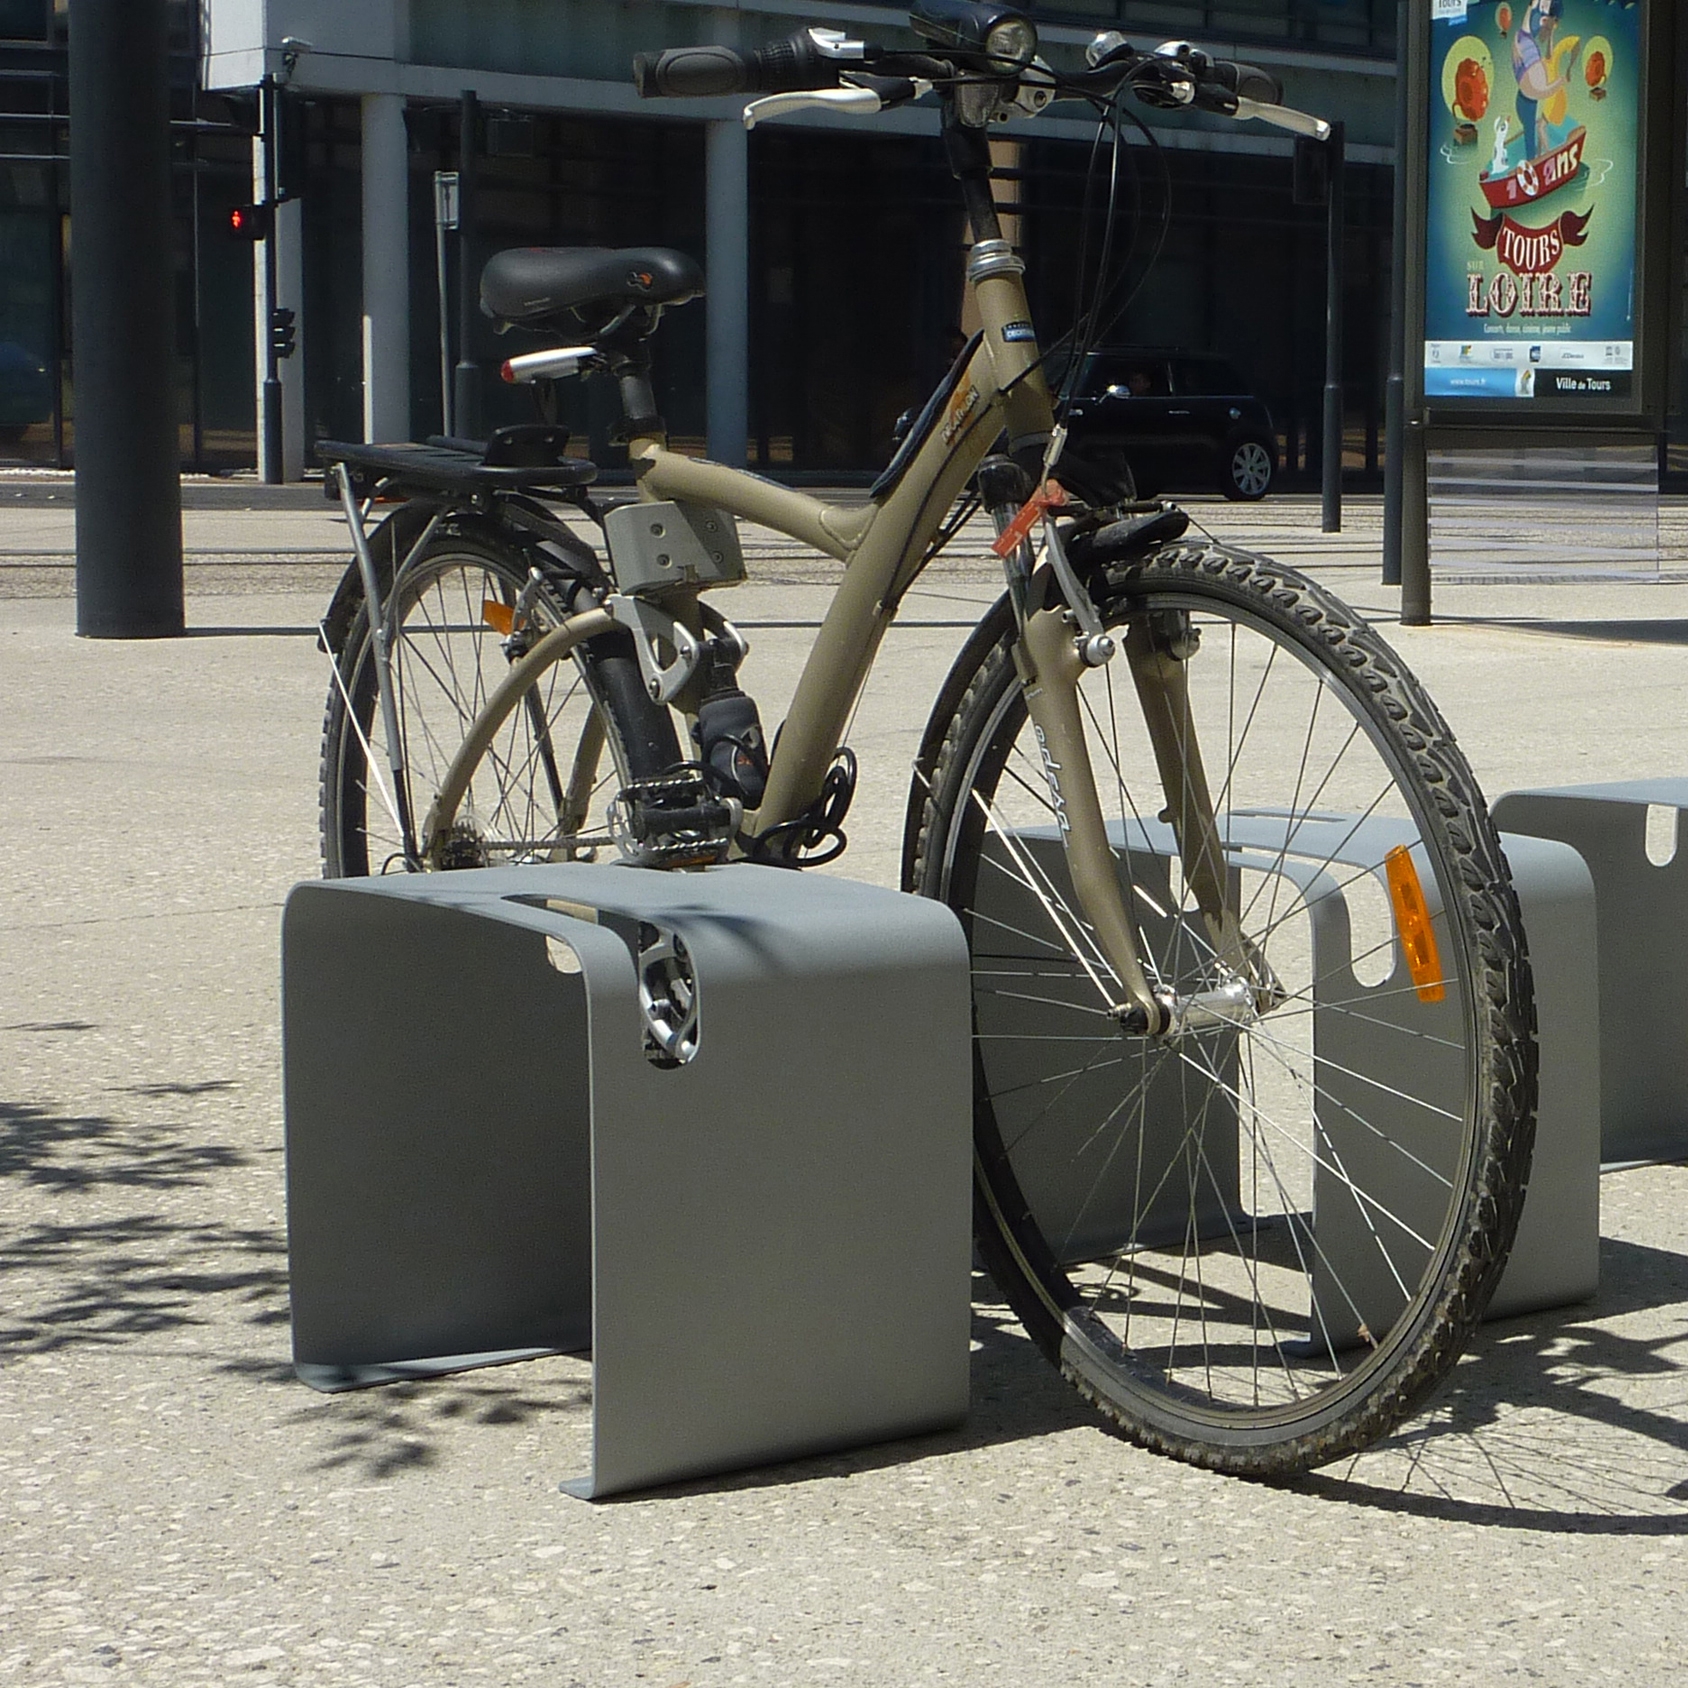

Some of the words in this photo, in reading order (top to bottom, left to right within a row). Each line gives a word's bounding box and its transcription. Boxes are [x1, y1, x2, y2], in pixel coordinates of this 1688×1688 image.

[1502, 227, 1560, 270] TOURS
[1465, 271, 1592, 318] LOIRE
[1556, 377, 1577, 389] Ville
[1587, 378, 1611, 390] Tours
